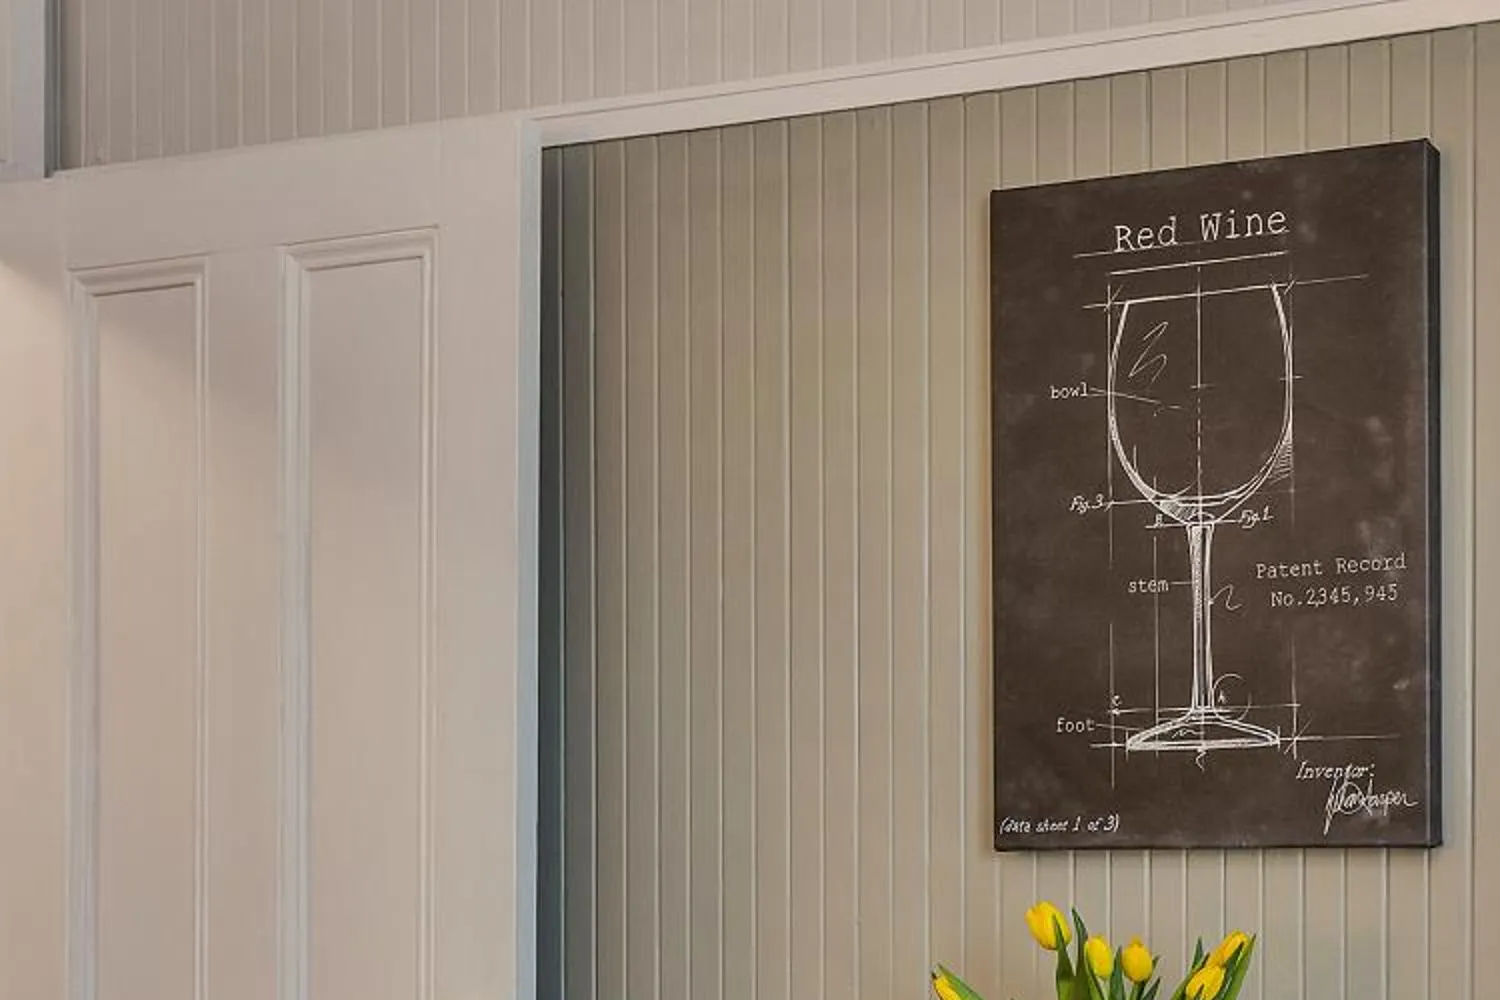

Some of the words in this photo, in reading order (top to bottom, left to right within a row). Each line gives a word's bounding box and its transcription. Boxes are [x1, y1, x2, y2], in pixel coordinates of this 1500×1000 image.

[1114, 215, 1178, 253] Red
[1200, 209, 1290, 241] Wine
[1050, 381, 1088, 399] bowl
[1255, 560, 1323, 579] Patent
[1335, 552, 1407, 575] Record
[1127, 579, 1170, 593] stem
[1056, 716, 1096, 733] foot
